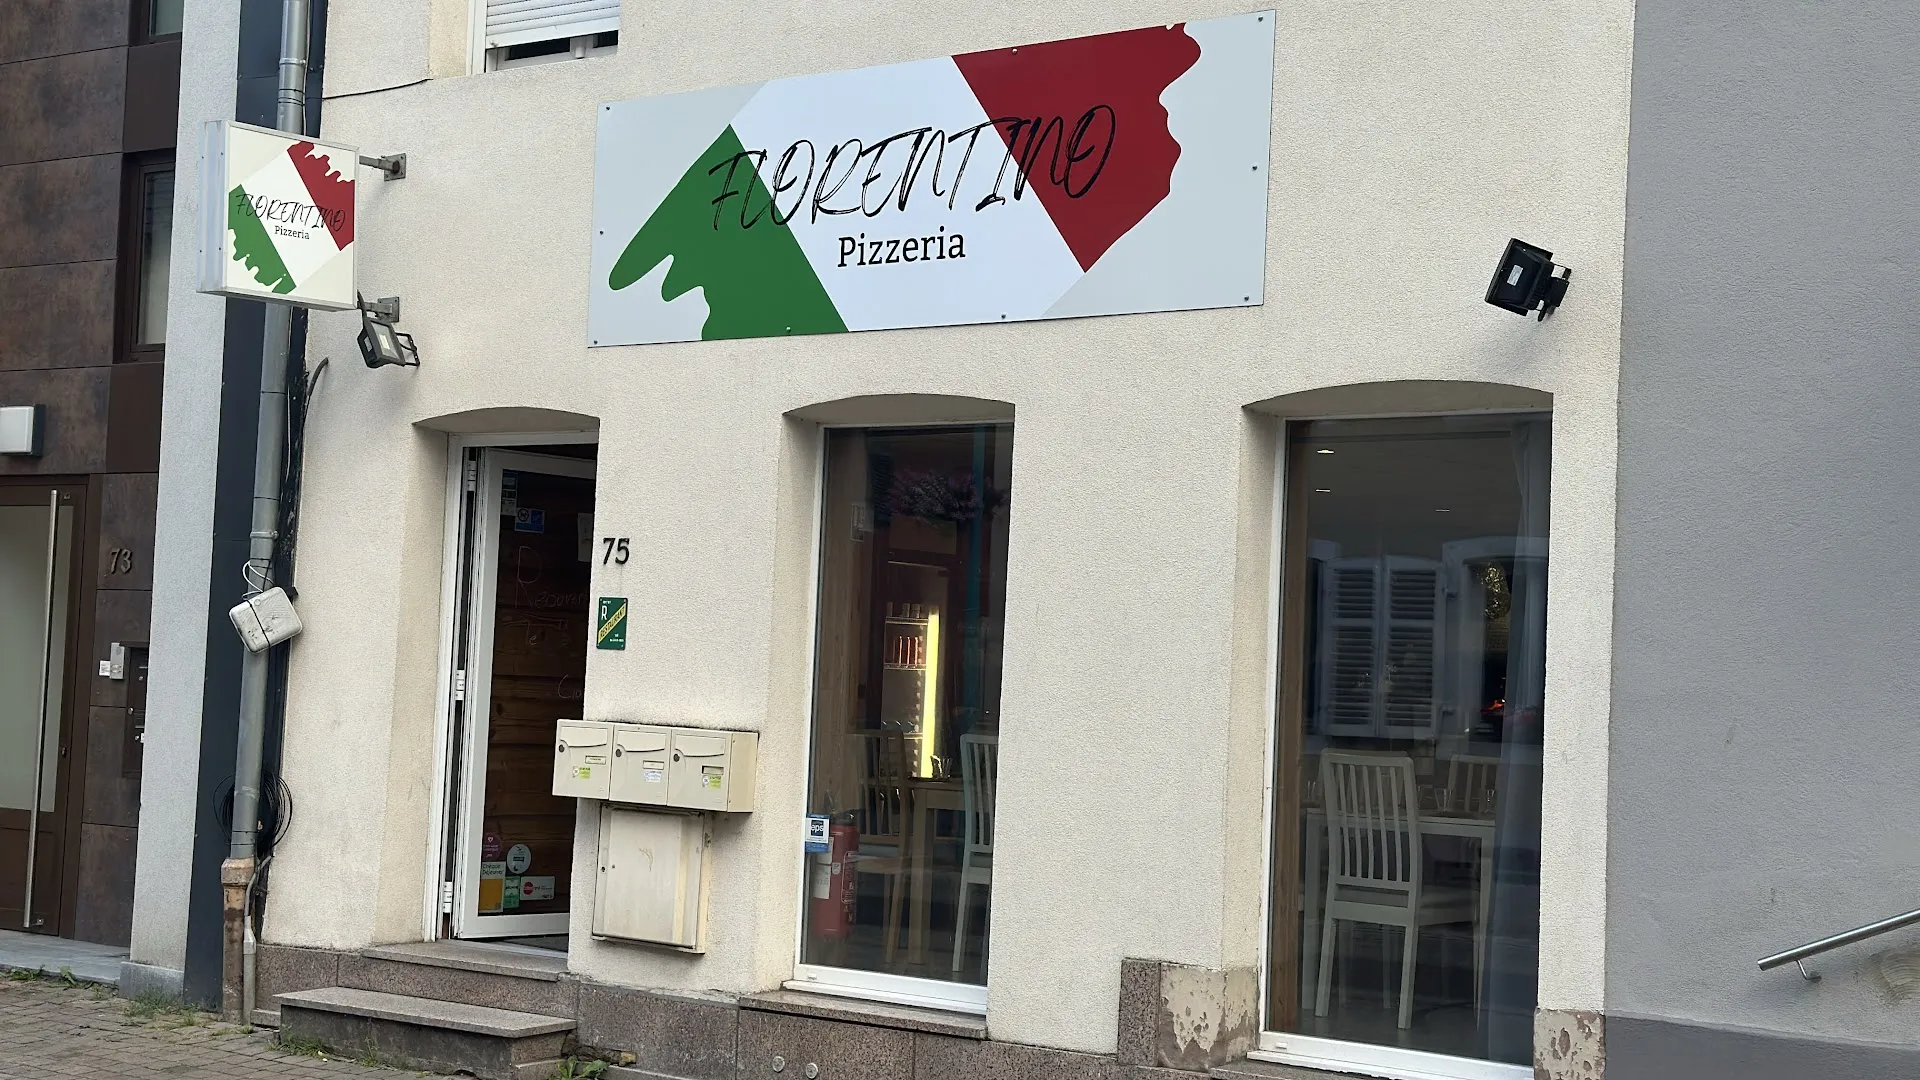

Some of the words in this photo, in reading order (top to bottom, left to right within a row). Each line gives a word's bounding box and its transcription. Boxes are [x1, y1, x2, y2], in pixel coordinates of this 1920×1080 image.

[274, 225, 310, 240] Pizzeria
[837, 225, 967, 268] Pizzeria
[110, 548, 133, 574] 73
[602, 537, 630, 566] 75
[601, 605, 608, 621] R
[811, 824, 824, 834] eps
